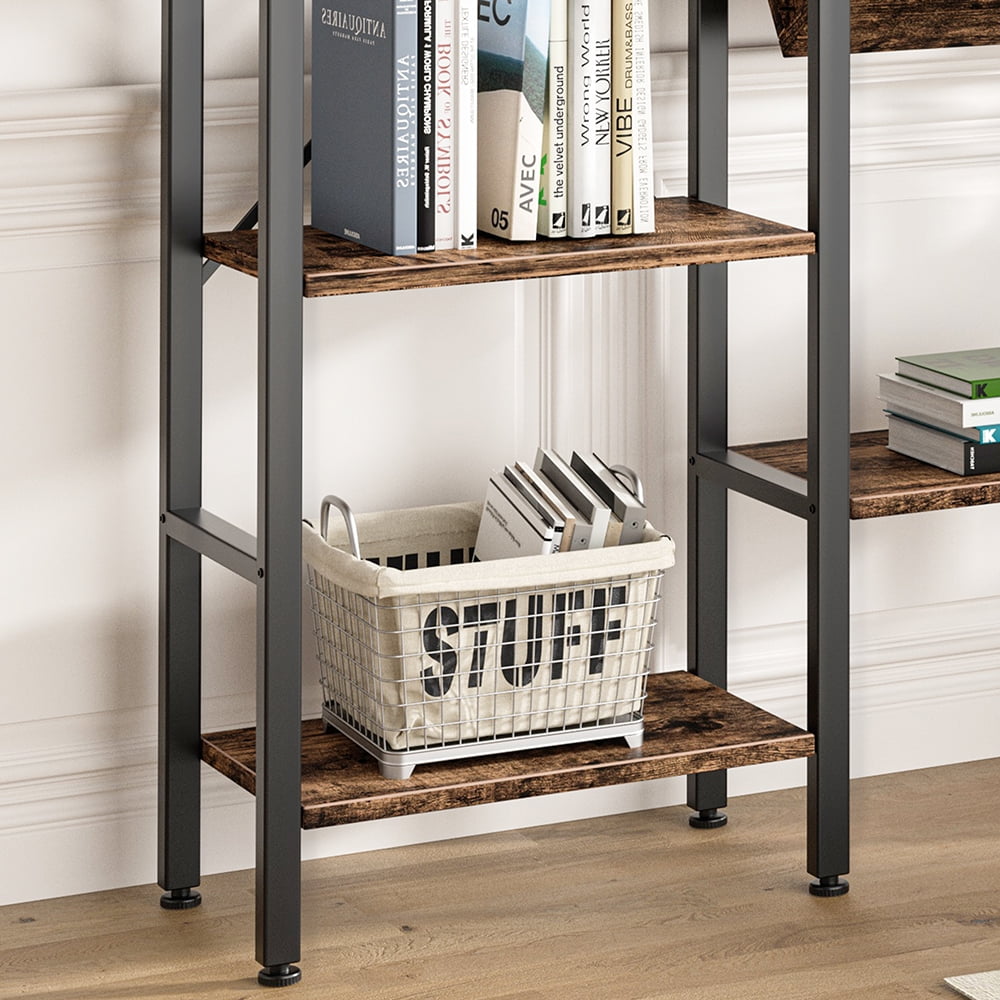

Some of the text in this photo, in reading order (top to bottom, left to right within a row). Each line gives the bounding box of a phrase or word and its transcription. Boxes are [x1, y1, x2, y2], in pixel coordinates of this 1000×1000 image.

[581, 4, 592, 146] Wrong World
[595, 38, 610, 146] NEW YORKER
[616, 2, 634, 158] VIBE DRUM&BASS
[519, 154, 536, 213] AVEC
[554, 66, 566, 198] the velvet underground
[491, 208, 509, 231] 05
[420, 585, 626, 697] STUFF
